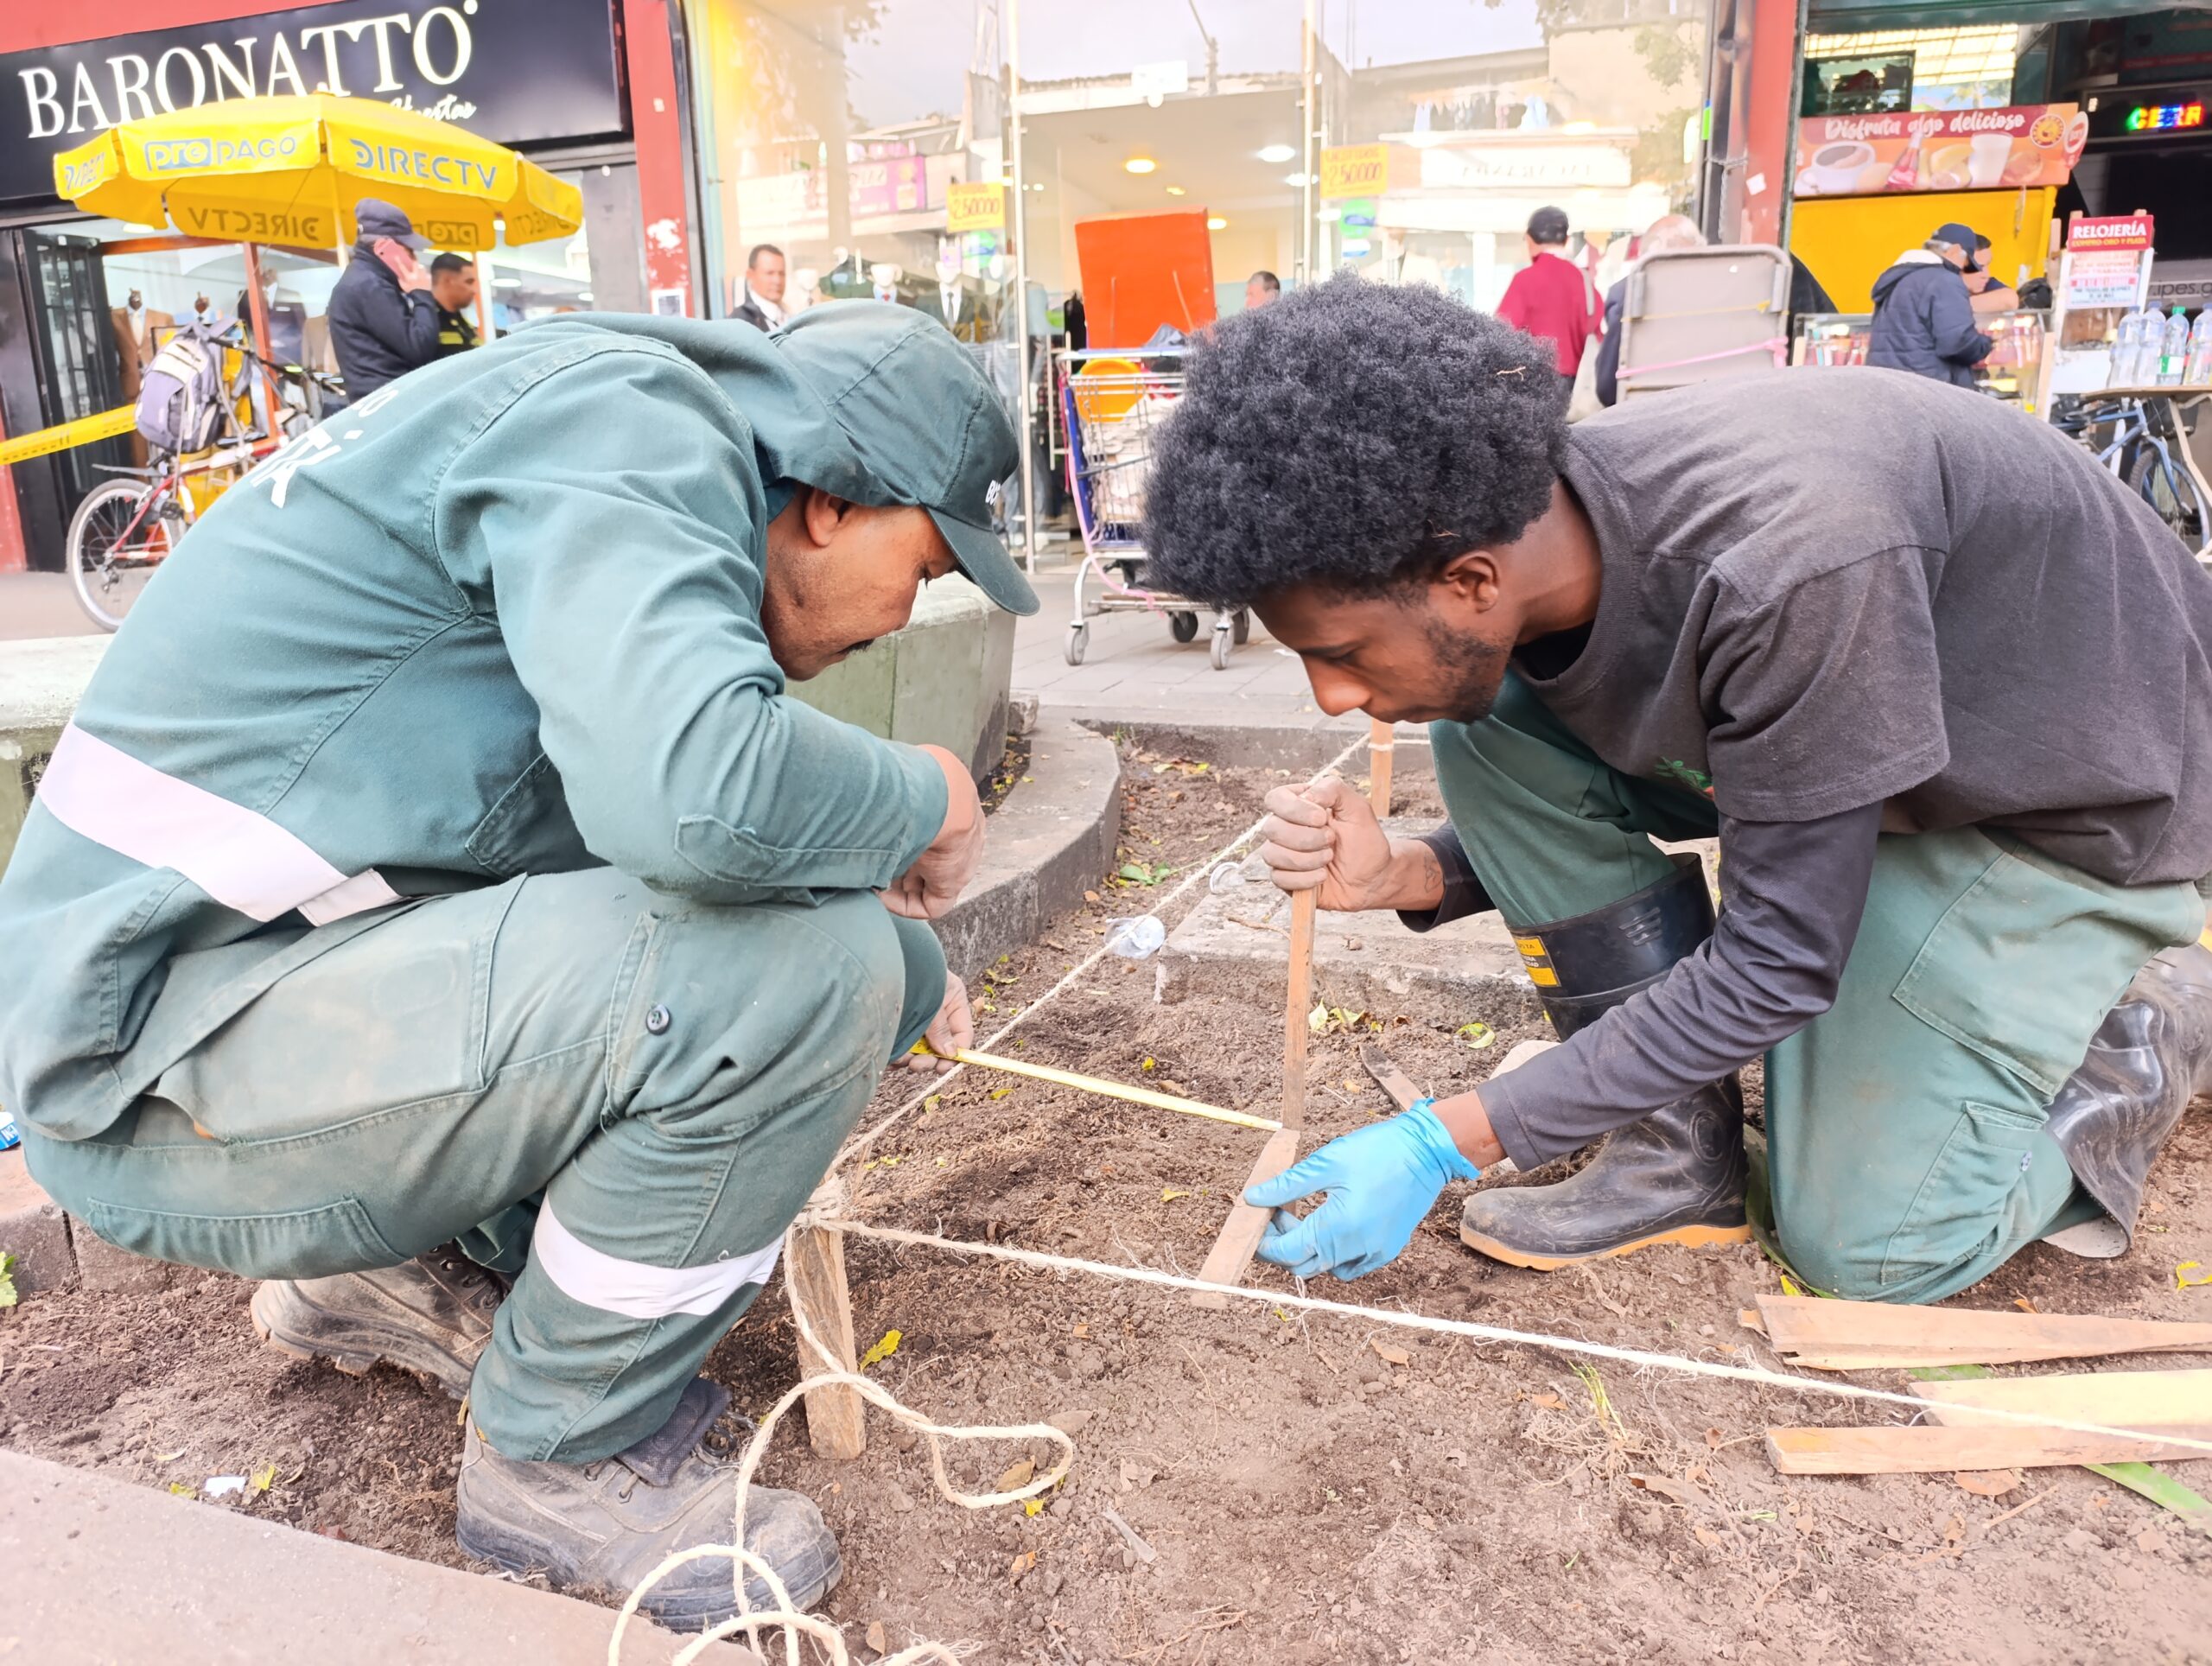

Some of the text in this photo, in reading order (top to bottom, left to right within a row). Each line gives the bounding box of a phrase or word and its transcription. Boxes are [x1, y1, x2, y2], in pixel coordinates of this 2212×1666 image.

[18, 6, 473, 138] BARONATTO
[1824, 118, 1901, 141] Disfruta
[1908, 116, 1944, 138] algo
[1949, 111, 2025, 133] delicioso
[349, 138, 496, 189] DIRECTV
[2073, 220, 2146, 238] RELOJERÍA
